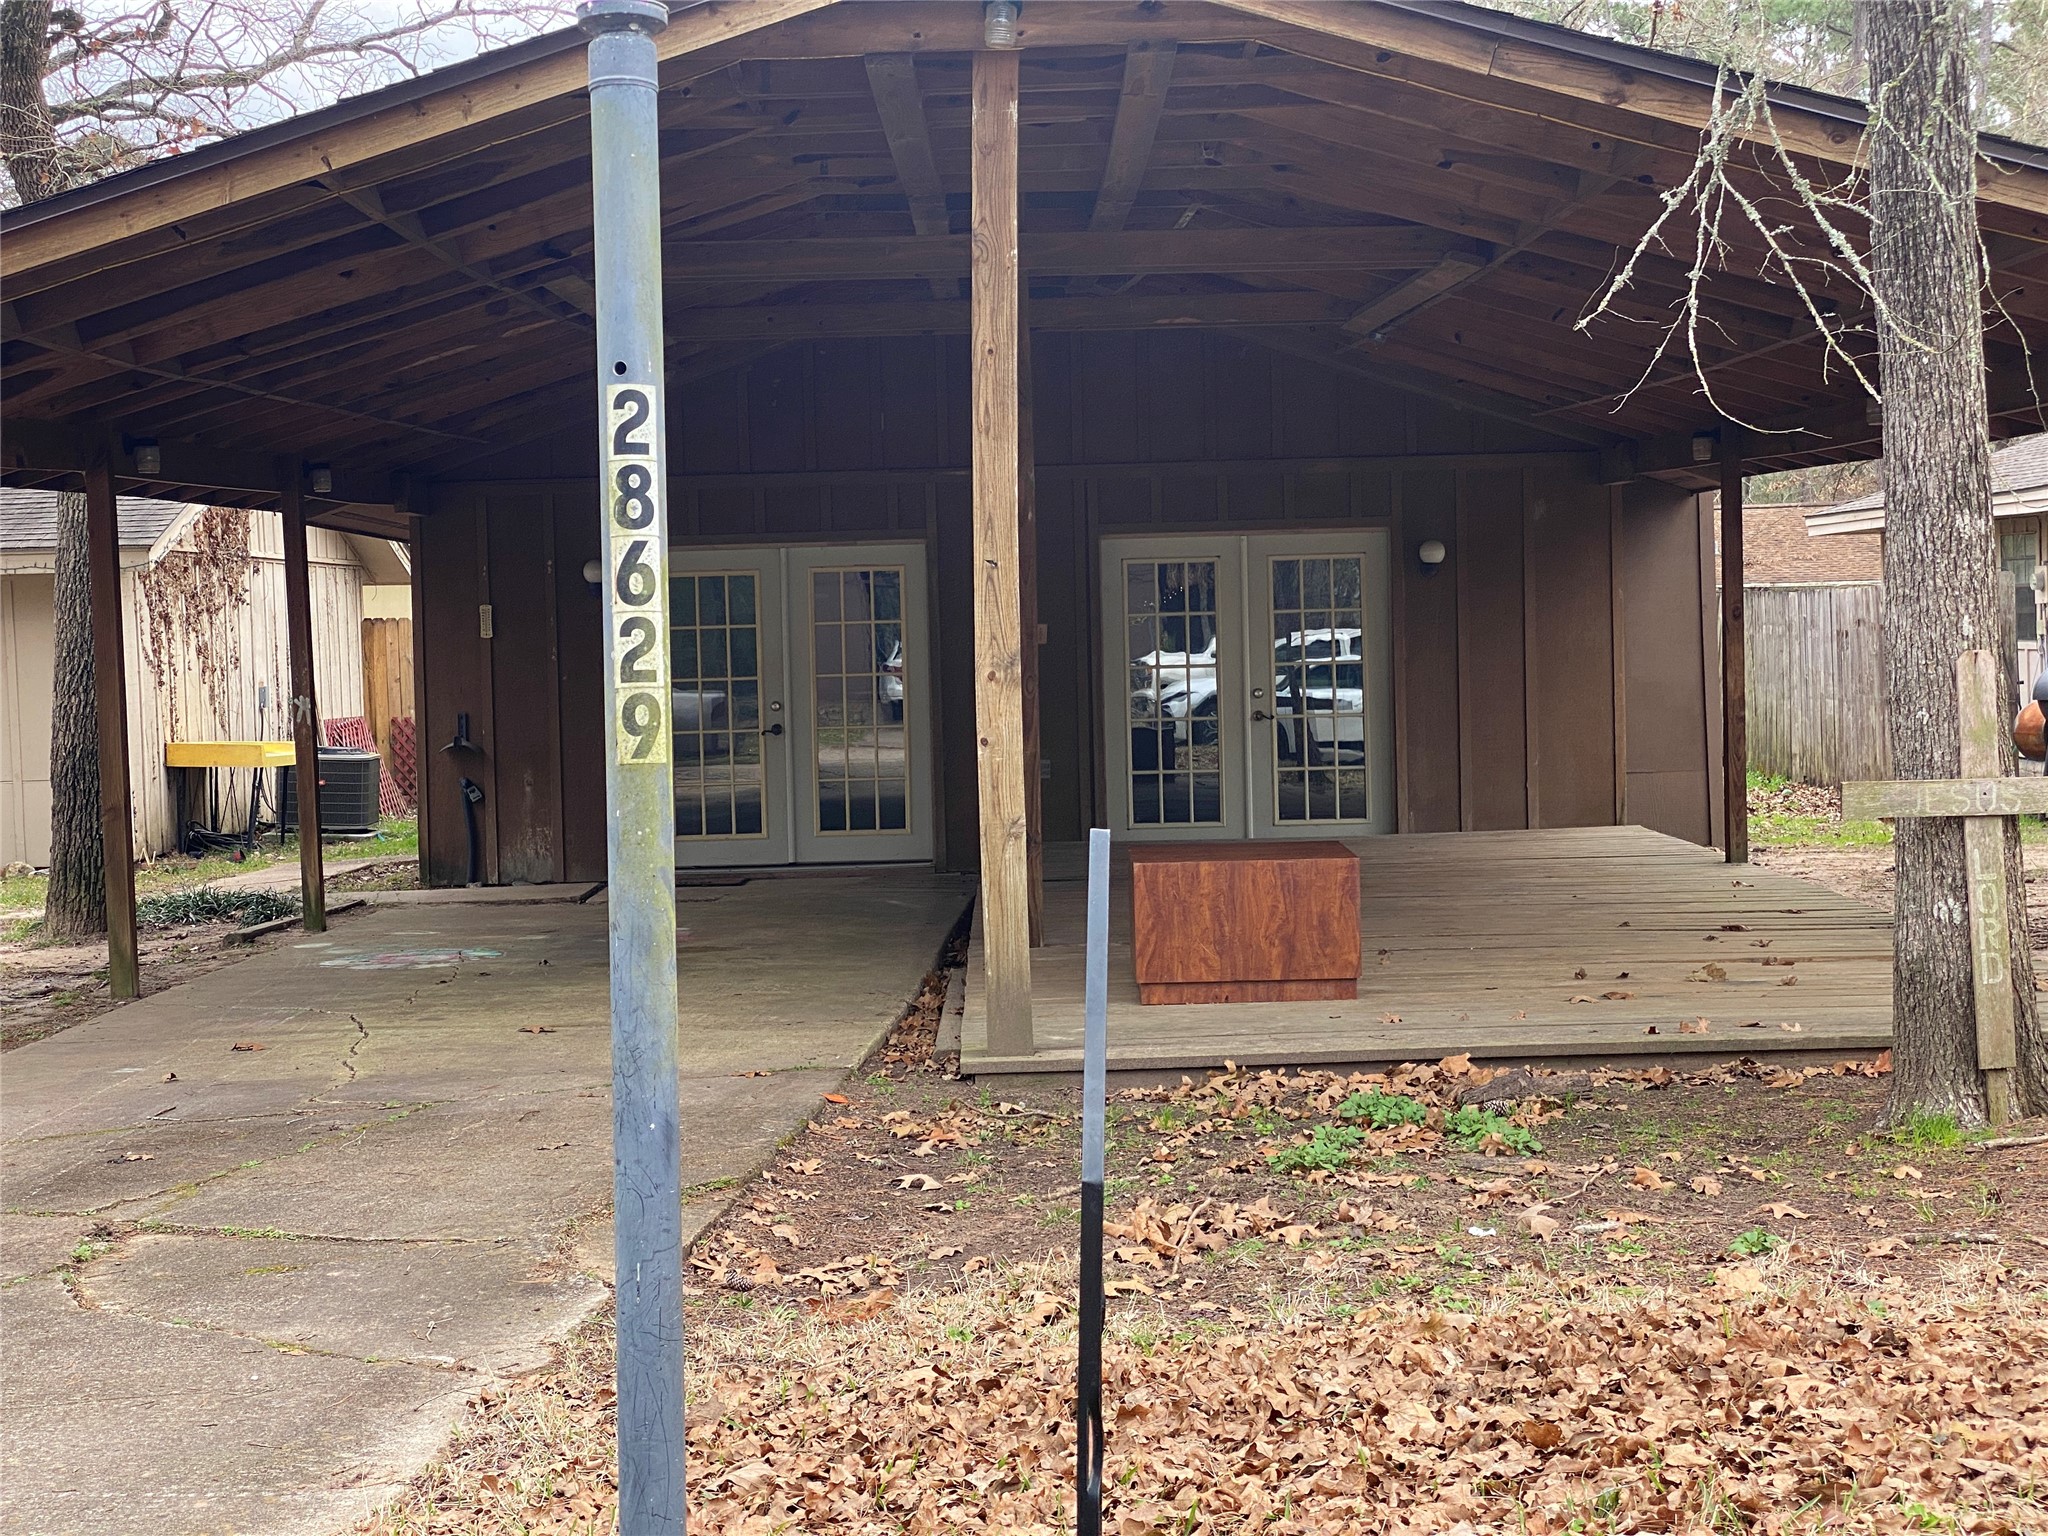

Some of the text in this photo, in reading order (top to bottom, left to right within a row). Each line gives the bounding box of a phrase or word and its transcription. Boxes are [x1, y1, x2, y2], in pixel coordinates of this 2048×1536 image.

[612, 388, 662, 760] 28629
[1912, 781, 2022, 814] JESUS
[1973, 848, 2004, 985] LORD
